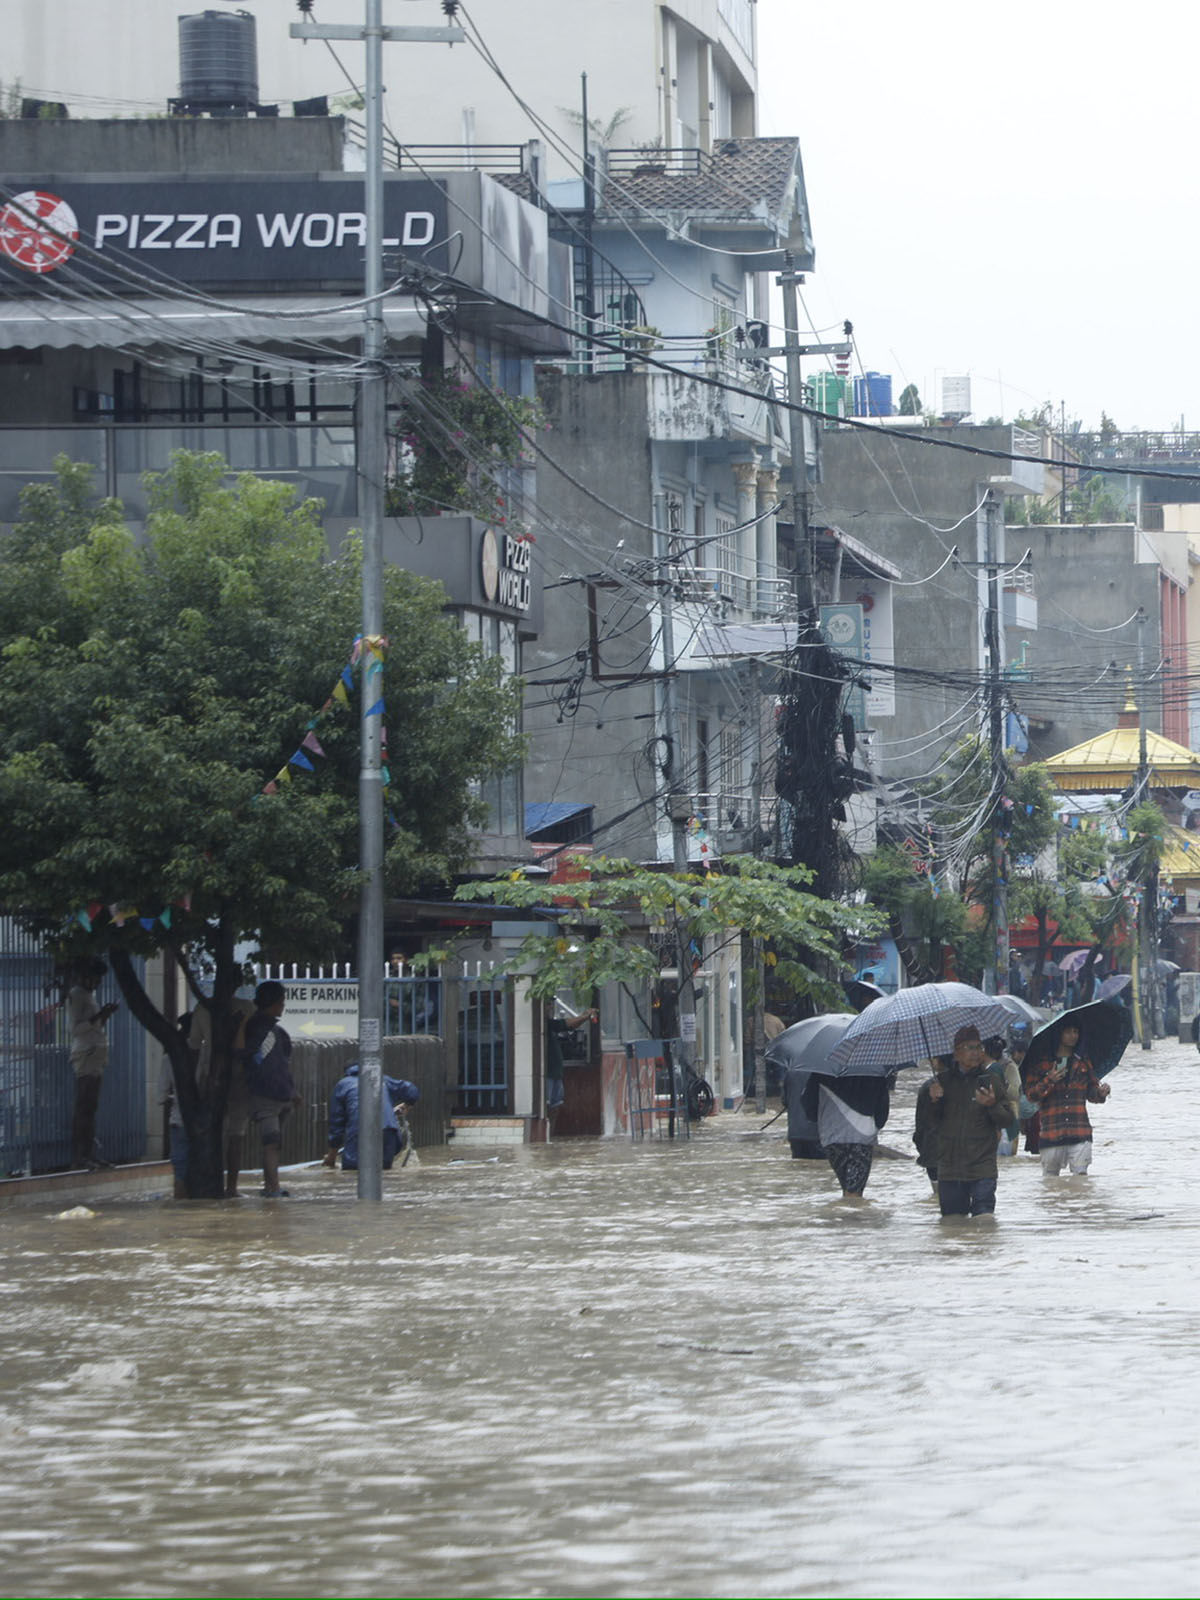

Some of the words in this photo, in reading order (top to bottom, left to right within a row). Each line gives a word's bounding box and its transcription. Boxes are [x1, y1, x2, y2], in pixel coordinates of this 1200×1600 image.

[95, 214, 241, 249] PIZZA
[499, 570, 530, 611] WORLD
[284, 987, 307, 1001] IKE
[311, 987, 360, 1001] PARKIN
